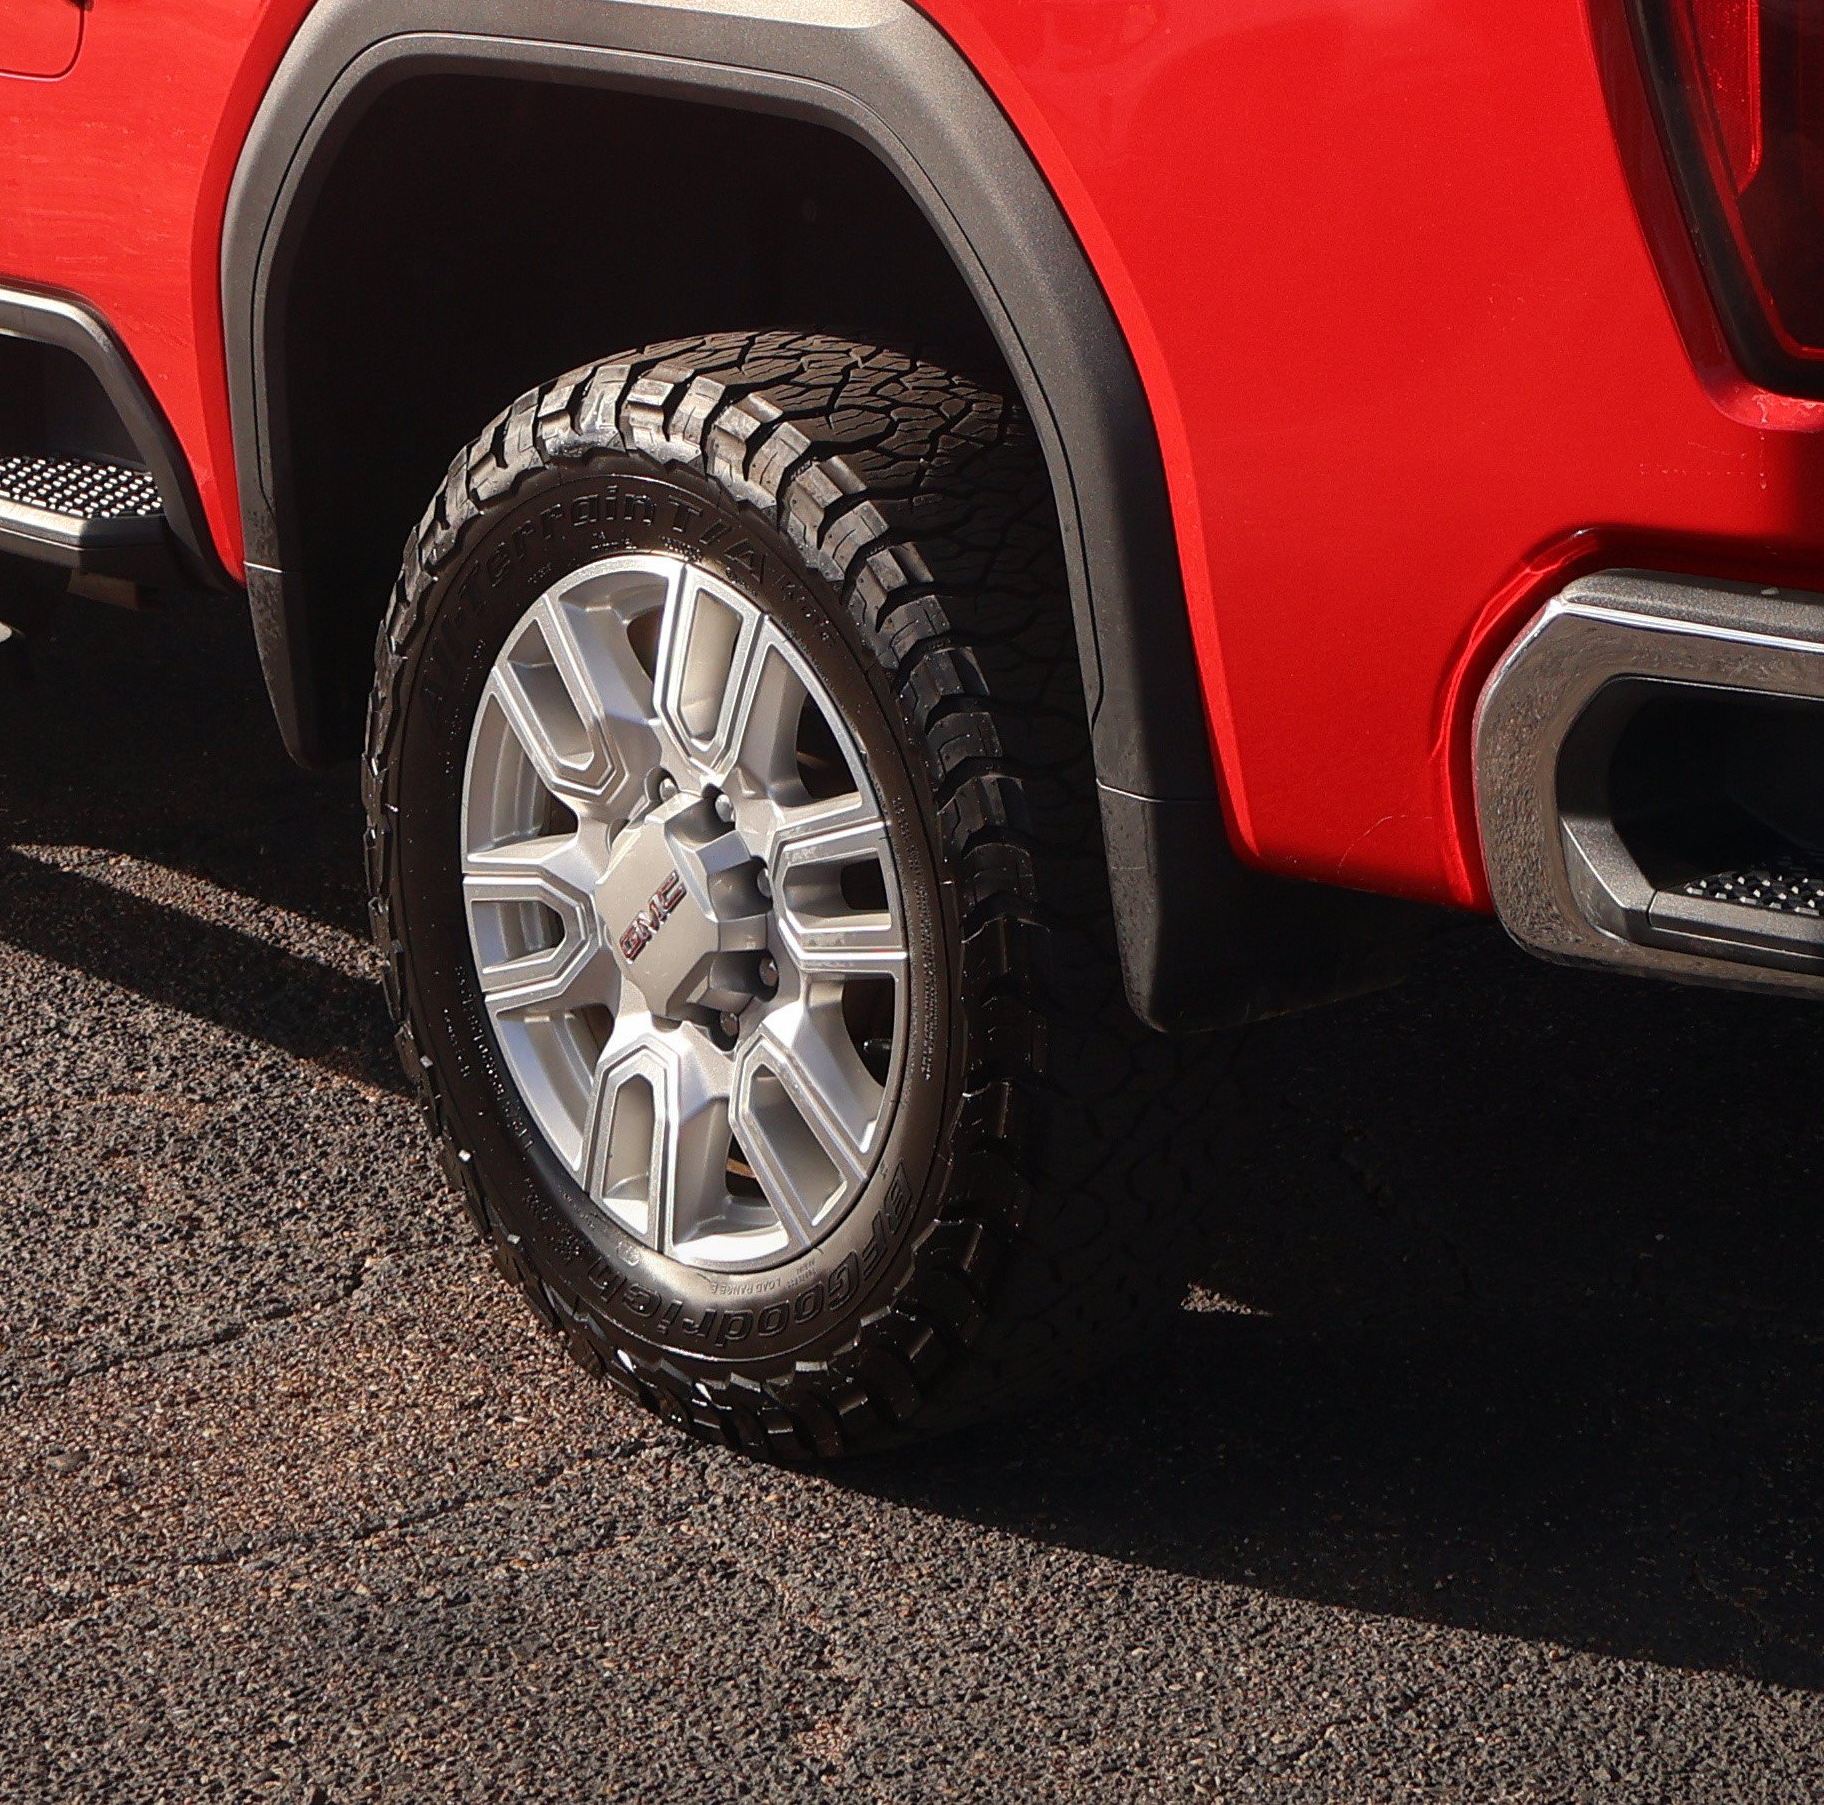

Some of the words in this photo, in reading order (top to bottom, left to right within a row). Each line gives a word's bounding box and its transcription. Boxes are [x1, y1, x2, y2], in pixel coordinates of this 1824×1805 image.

[618, 870, 688, 965] GMC
[586, 1160, 914, 1347] BFGoodrich
[720, 1282, 753, 1295] RANGE
[756, 1276, 781, 1291] LOAD
